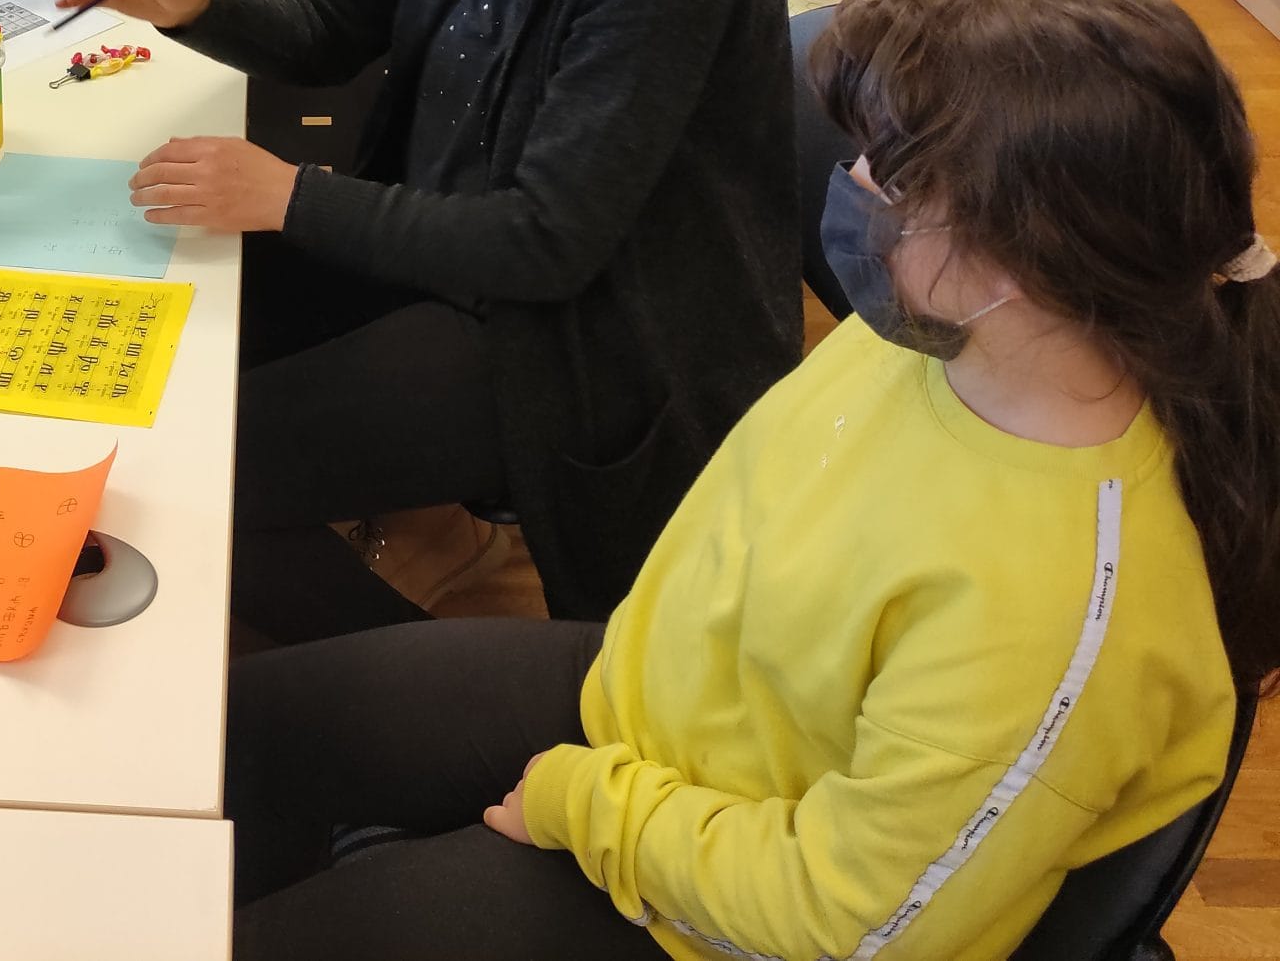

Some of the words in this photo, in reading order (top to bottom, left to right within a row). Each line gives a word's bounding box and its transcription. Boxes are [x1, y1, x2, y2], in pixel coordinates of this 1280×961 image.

[1095, 562, 1113, 621] Champion
[1037, 696, 1070, 751] Champion
[961, 806, 999, 850] Champion
